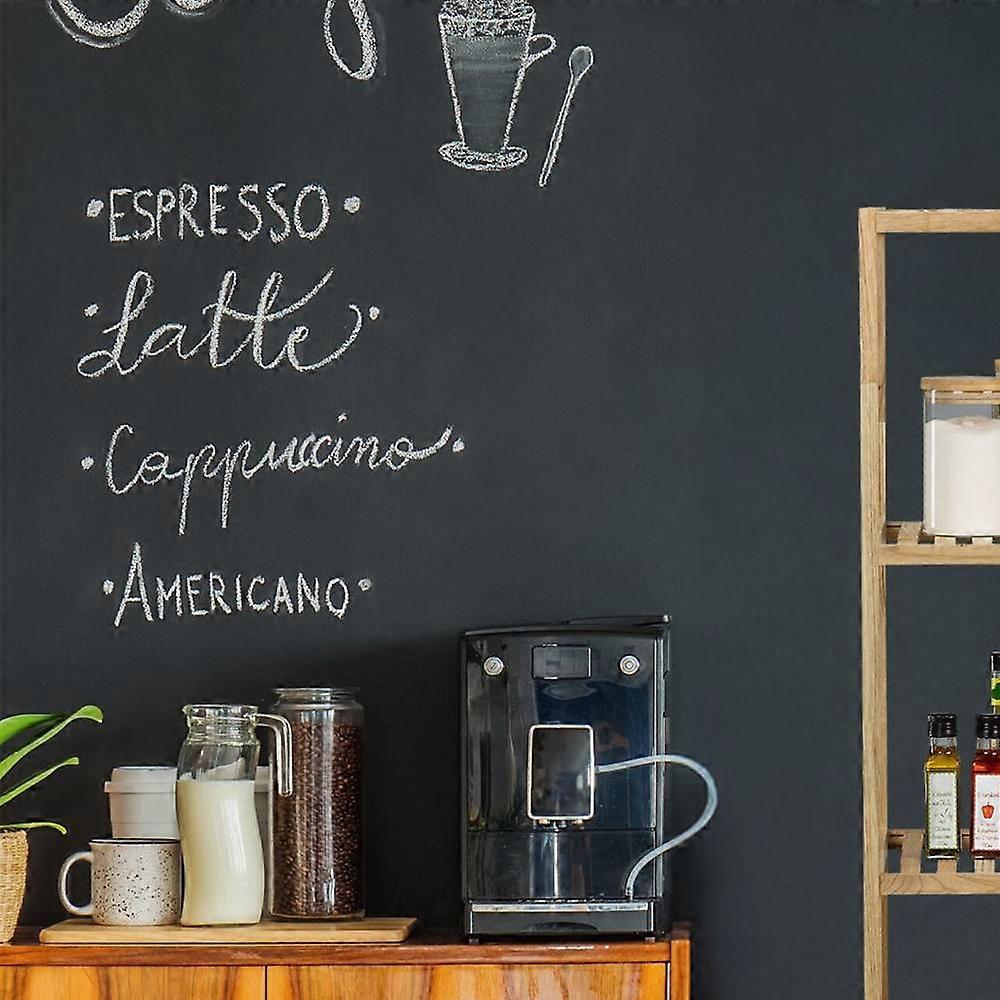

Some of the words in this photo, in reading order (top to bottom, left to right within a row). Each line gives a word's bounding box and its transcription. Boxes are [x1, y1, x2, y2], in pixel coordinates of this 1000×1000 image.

[109, 183, 330, 243] ESPRESSO
[78, 267, 362, 377] Latte
[105, 413, 452, 535] Cappuccino
